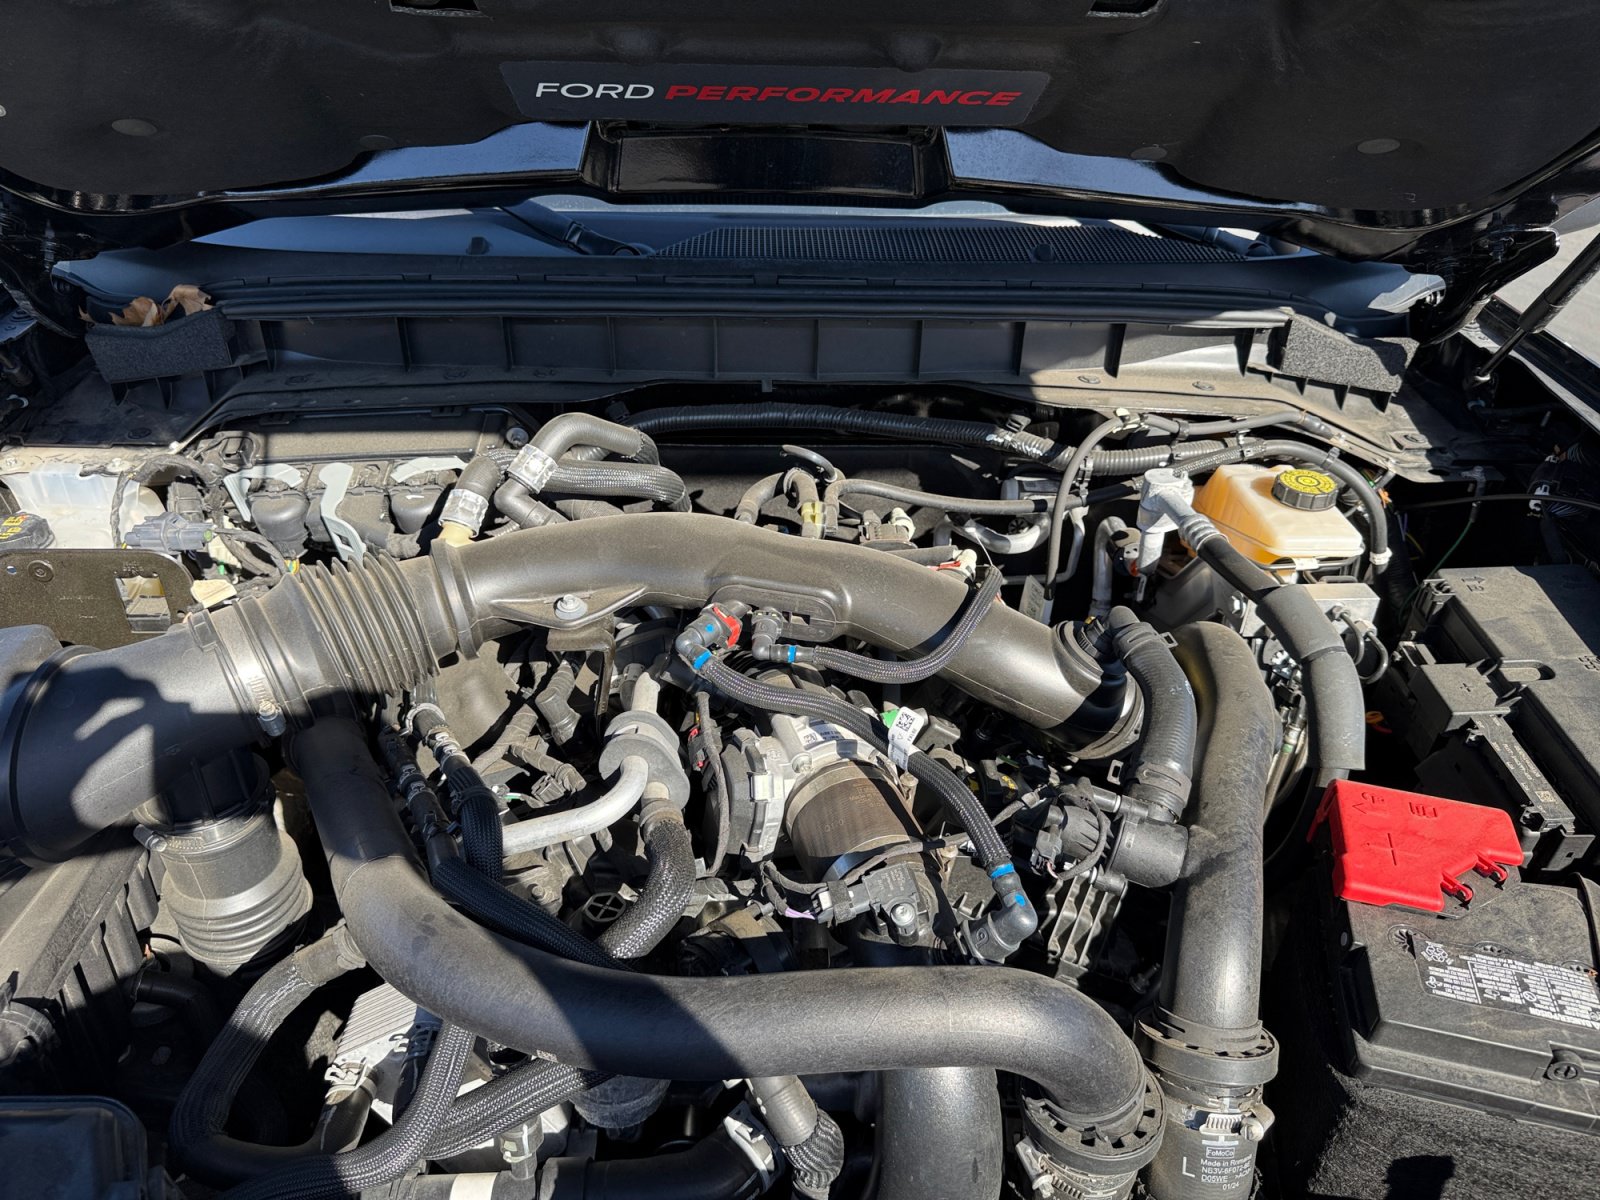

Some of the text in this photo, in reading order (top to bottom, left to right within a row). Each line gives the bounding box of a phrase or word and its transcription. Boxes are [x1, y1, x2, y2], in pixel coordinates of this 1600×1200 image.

[535, 82, 1022, 106] FORD PERFORMANCE
[1207, 1149, 1234, 1157] FoMoCo
[1182, 1156, 1196, 1178] L
[1200, 1158, 1221, 1168] Made
